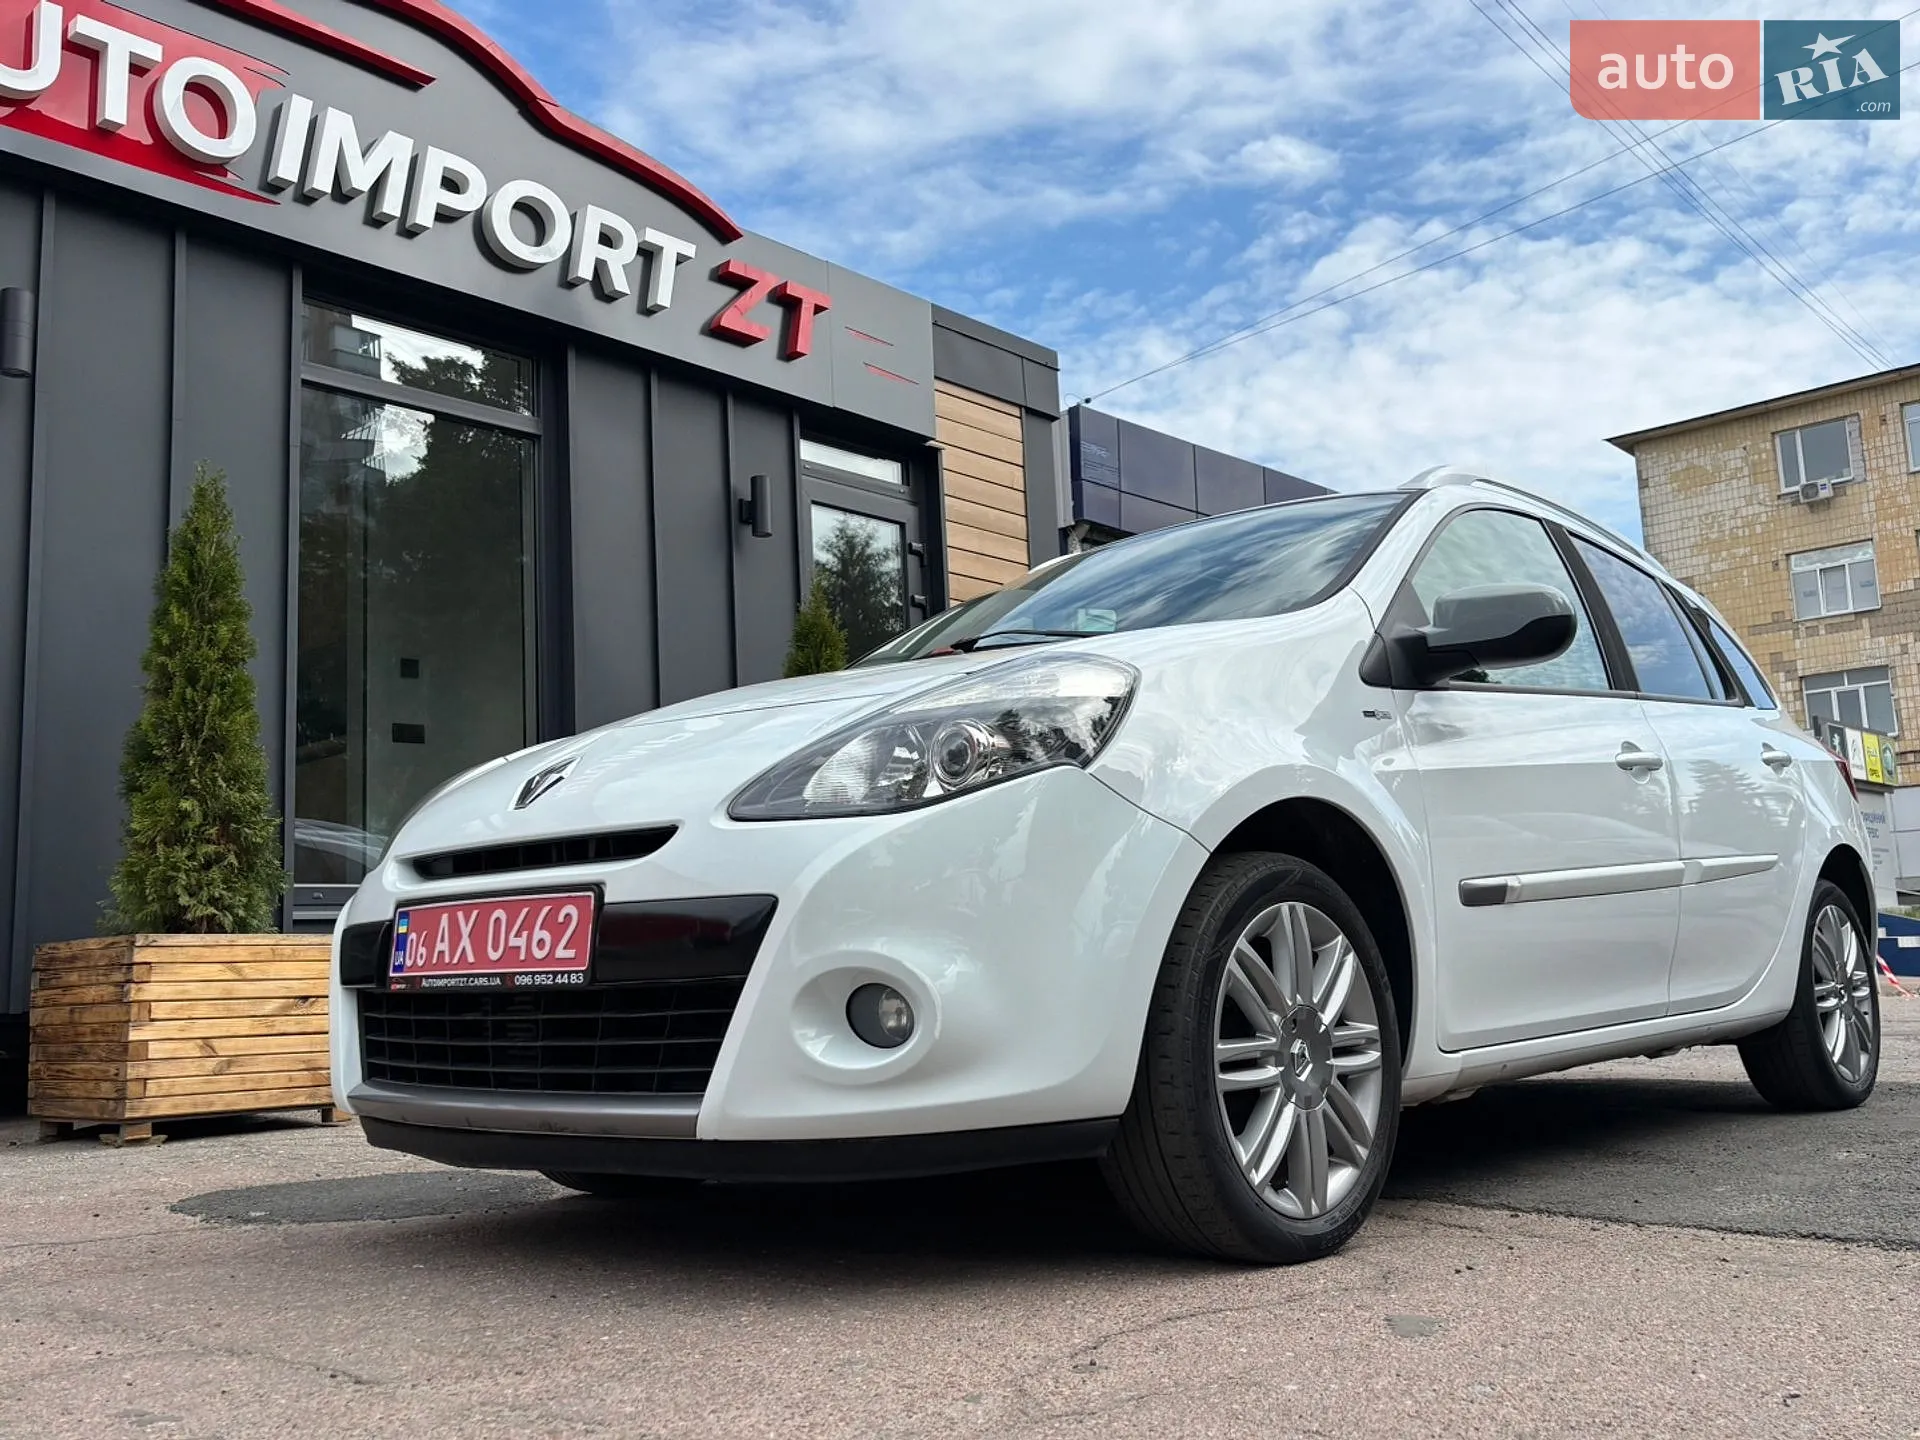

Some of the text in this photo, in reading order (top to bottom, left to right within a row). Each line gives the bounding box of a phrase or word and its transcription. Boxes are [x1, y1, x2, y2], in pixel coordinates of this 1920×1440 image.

[708, 258, 831, 361] ZT
[405, 903, 580, 968] 06 AX 0462
[514, 974, 534, 985] 096
[533, 974, 554, 985] 952
[569, 973, 585, 984] 83
